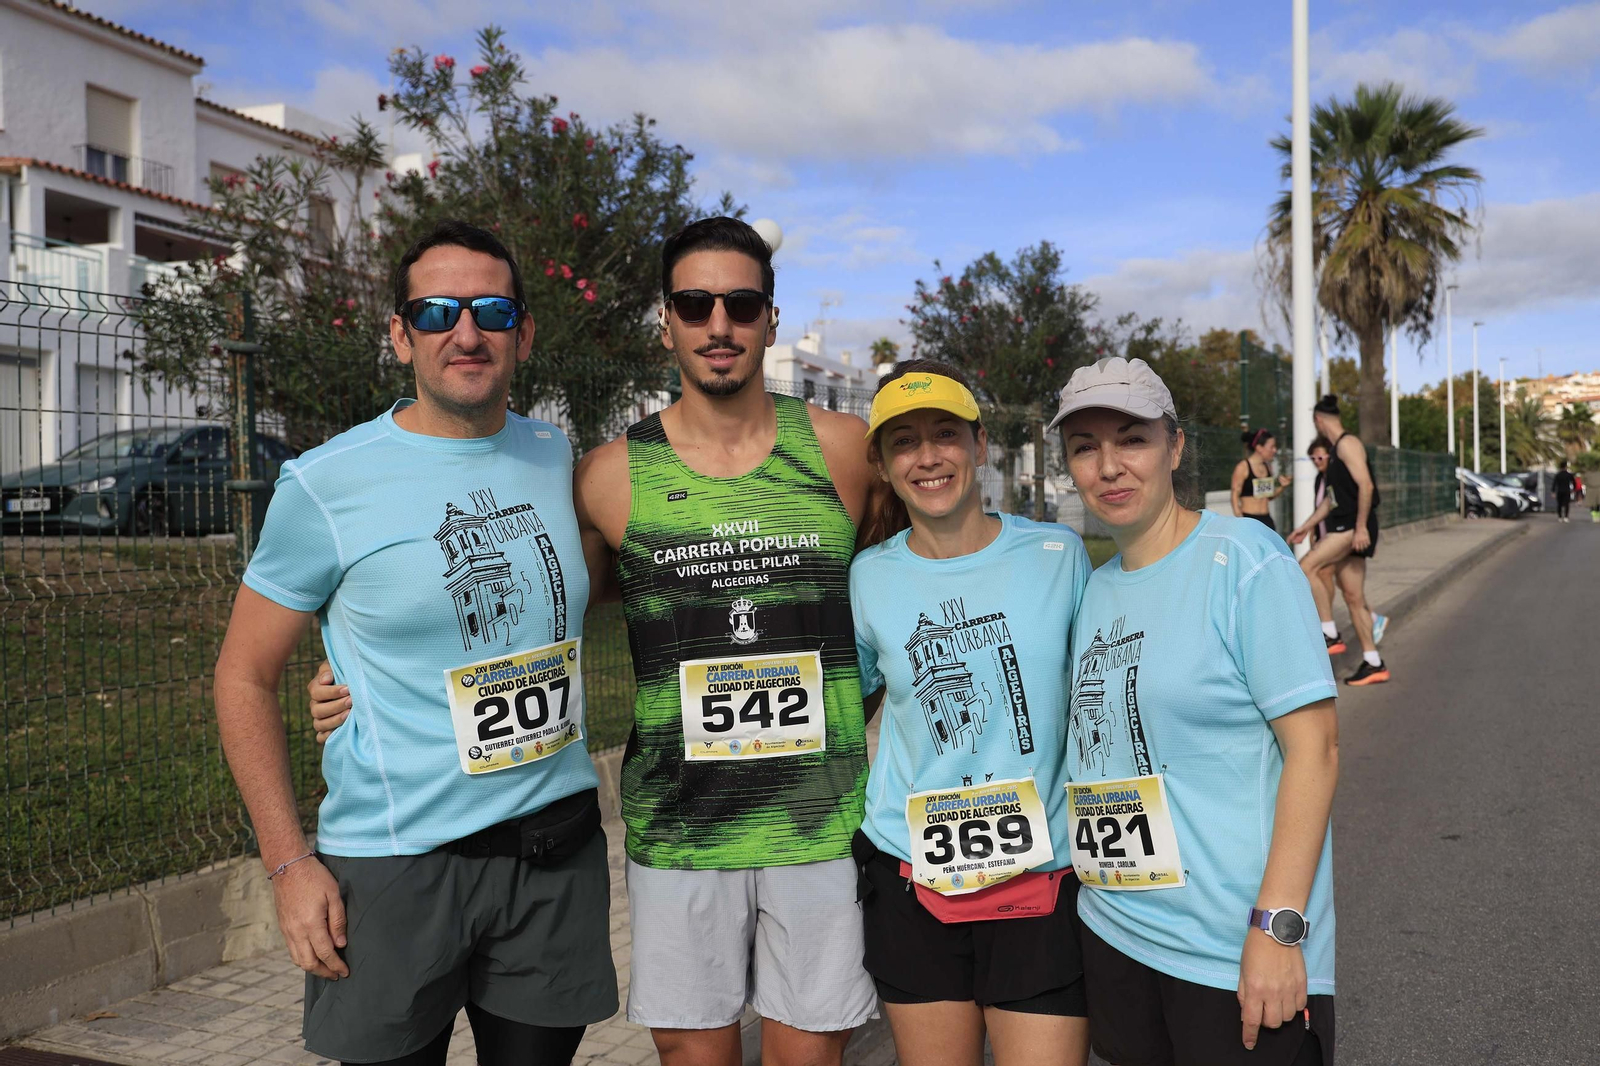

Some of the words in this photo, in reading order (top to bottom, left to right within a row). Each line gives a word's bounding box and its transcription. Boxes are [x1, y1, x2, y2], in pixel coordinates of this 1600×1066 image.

[467, 487, 498, 515] XXV
[488, 503, 534, 521] CARRERA
[488, 511, 545, 543] URBANA
[712, 520, 760, 537] XXVII
[654, 541, 734, 564] CARRERA
[740, 534, 820, 553] POPULAR
[676, 561, 728, 578] VIRGEN
[732, 559, 759, 572] DEL
[762, 554, 800, 569] PILAR
[537, 536, 565, 639] ALGECIRAS
[711, 574, 770, 588] ALGECIRAS
[939, 597, 967, 625] XXV
[954, 612, 1006, 631] CARRERA
[955, 621, 1012, 654] URBANA
[1106, 614, 1126, 642] XXV
[1110, 631, 1144, 648] CARRERA
[475, 665, 488, 674] XXV
[489, 659, 513, 670] EDICIÓN
[707, 664, 718, 672] XXV
[720, 662, 744, 671] EDICIÓN
[1105, 641, 1142, 672] URBANA
[474, 665, 527, 686] CARRERA
[527, 654, 565, 674] URBANA
[478, 680, 515, 697] CIUDAD
[516, 676, 528, 689] DE
[529, 666, 566, 686] ALGECIRAS
[706, 668, 755, 683] CARRERA
[757, 665, 800, 678] URBANA
[708, 681, 742, 694] CIUDAD
[744, 680, 755, 690] DE
[756, 676, 801, 690] ALGECIRAS
[474, 676, 570, 742] 207
[702, 687, 809, 732] 542
[1001, 648, 1031, 750] ALGECIRAS
[1127, 669, 1150, 776] ALGECIRAS
[485, 738, 514, 752] GUTIERREZ
[516, 731, 542, 744] GUTIERREZ
[925, 798, 972, 814] CARRERA
[972, 792, 1020, 808] URBANA
[926, 795, 937, 803] XXV
[938, 792, 961, 802] EDICIÓN
[1074, 793, 1103, 806] CARRERA
[1103, 790, 1142, 804] URBANA
[927, 811, 959, 824] CIUDAD
[961, 809, 972, 820] DE
[973, 803, 1022, 818] ALGECIRAS
[1076, 806, 1095, 817] CIUDAD
[1096, 806, 1105, 816] DE
[1106, 802, 1144, 815] ALGECIRAS
[924, 814, 1034, 865] 369
[1076, 814, 1155, 858] 421
[943, 864, 956, 874] PEÑA
[988, 858, 1016, 869] ESTEFANIA
[1116, 860, 1137, 868] CAROLINA
